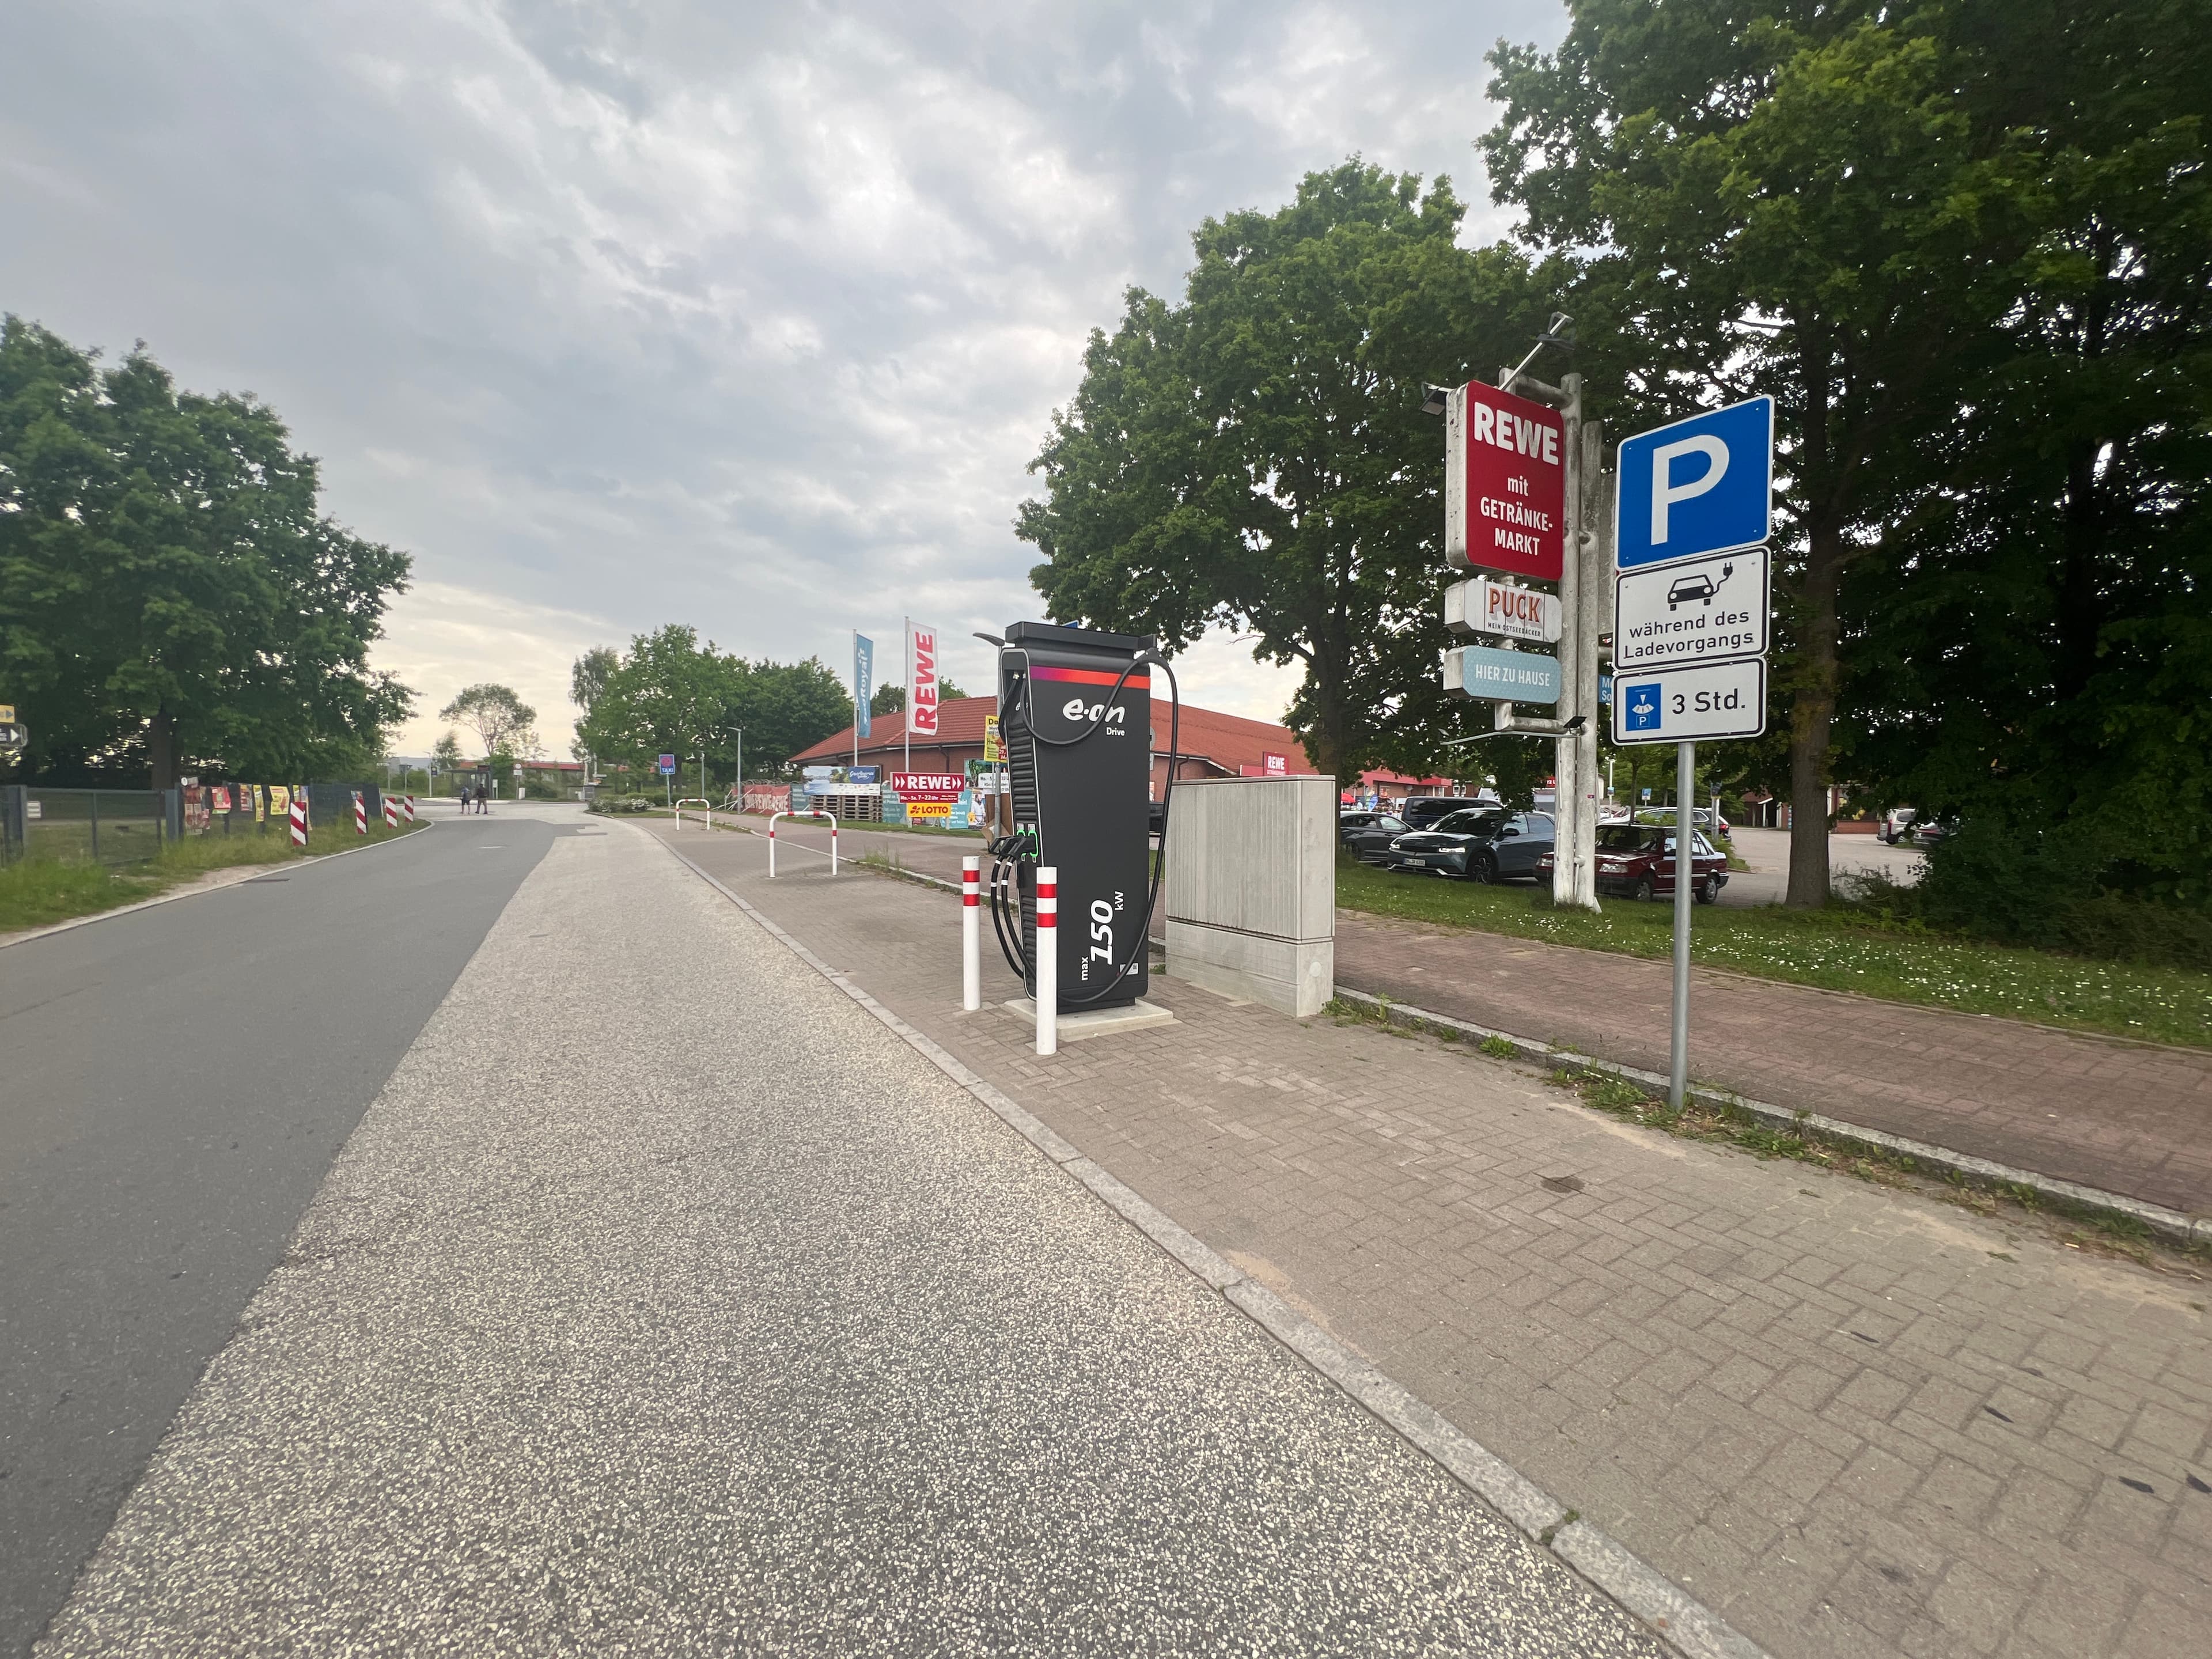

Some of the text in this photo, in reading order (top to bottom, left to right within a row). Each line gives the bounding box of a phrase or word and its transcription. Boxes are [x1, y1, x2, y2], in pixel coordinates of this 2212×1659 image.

[1474, 402, 1559, 465] REWE
[1508, 475, 1529, 497] mit
[1650, 434, 1730, 546] P
[1480, 497, 1553, 532] GETRÄNKE-
[1494, 528, 1540, 556] MARKT
[1488, 588, 1541, 623] PUCK
[1630, 611, 1749, 638] während des
[1624, 632, 1754, 659] Ladevorgangs
[915, 631, 937, 730] REWE
[1476, 664, 1550, 687] HIER ZU HAUSE
[1672, 688, 1745, 714] 3 Std.
[1106, 727, 1125, 736] Drive
[1639, 717, 1647, 726] P
[1267, 755, 1285, 770] REWE
[907, 776, 952, 790] REWE
[1090, 900, 1113, 965] 150
[1114, 891, 1124, 911] kW
